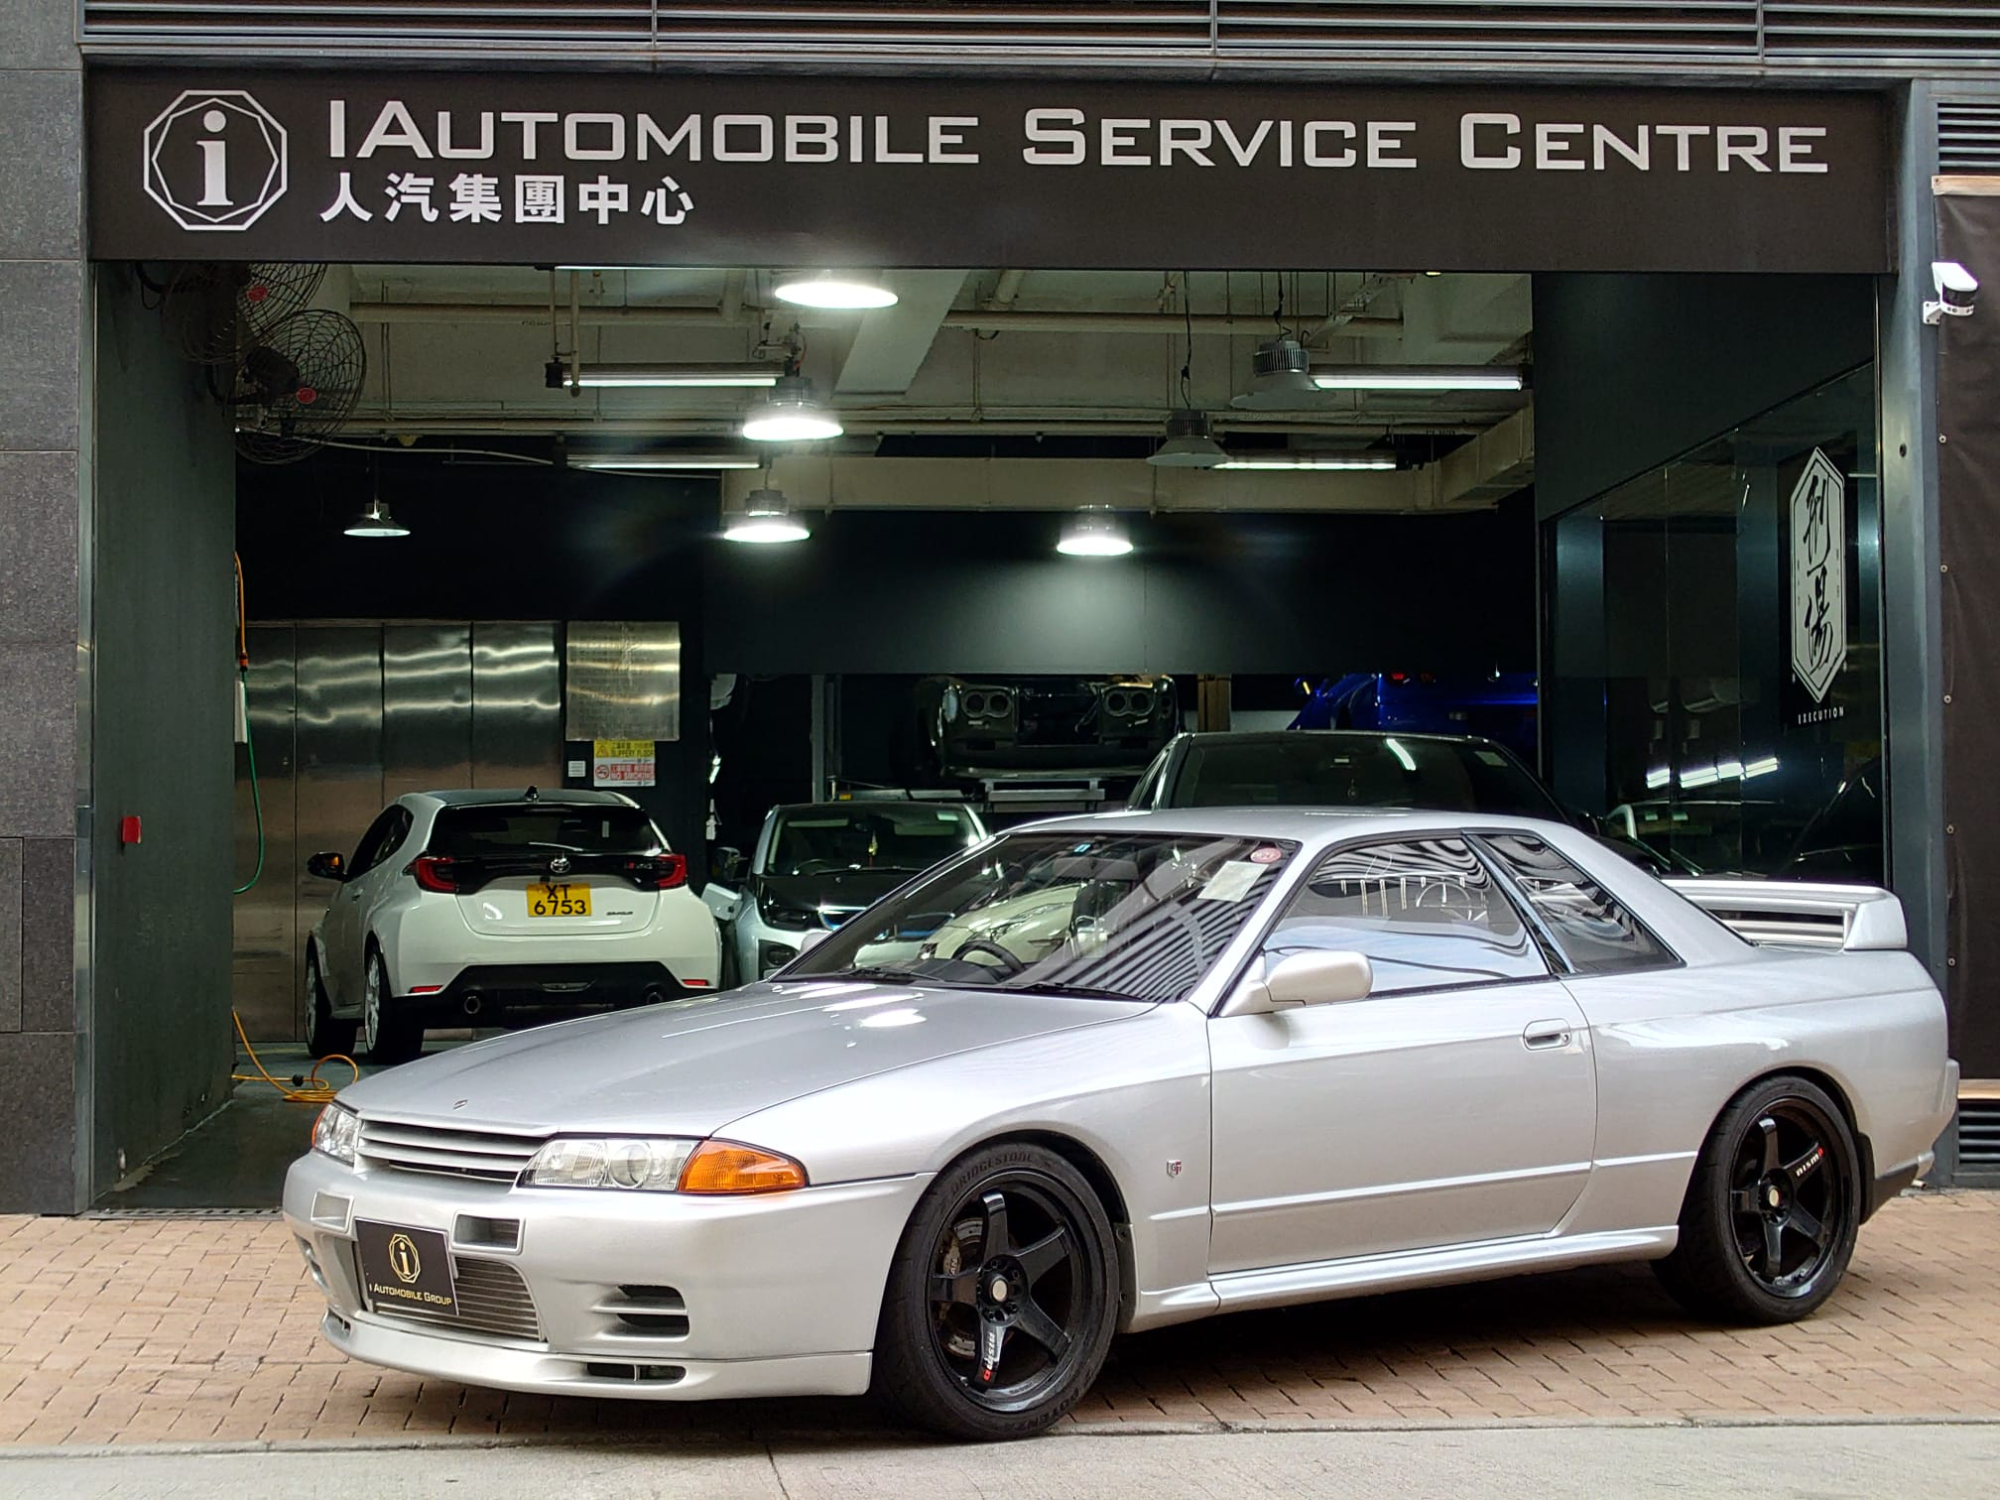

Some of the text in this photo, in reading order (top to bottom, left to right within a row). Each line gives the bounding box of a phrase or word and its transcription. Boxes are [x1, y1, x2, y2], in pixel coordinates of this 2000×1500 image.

[1023, 109, 1417, 168] SERVICE
[1461, 114, 1828, 173] CENTRE
[320, 173, 694, 225] 人汽集團中心
[1798, 706, 1844, 724] EXECUTION
[545, 884, 571, 900] XT
[534, 900, 586, 915] 6753
